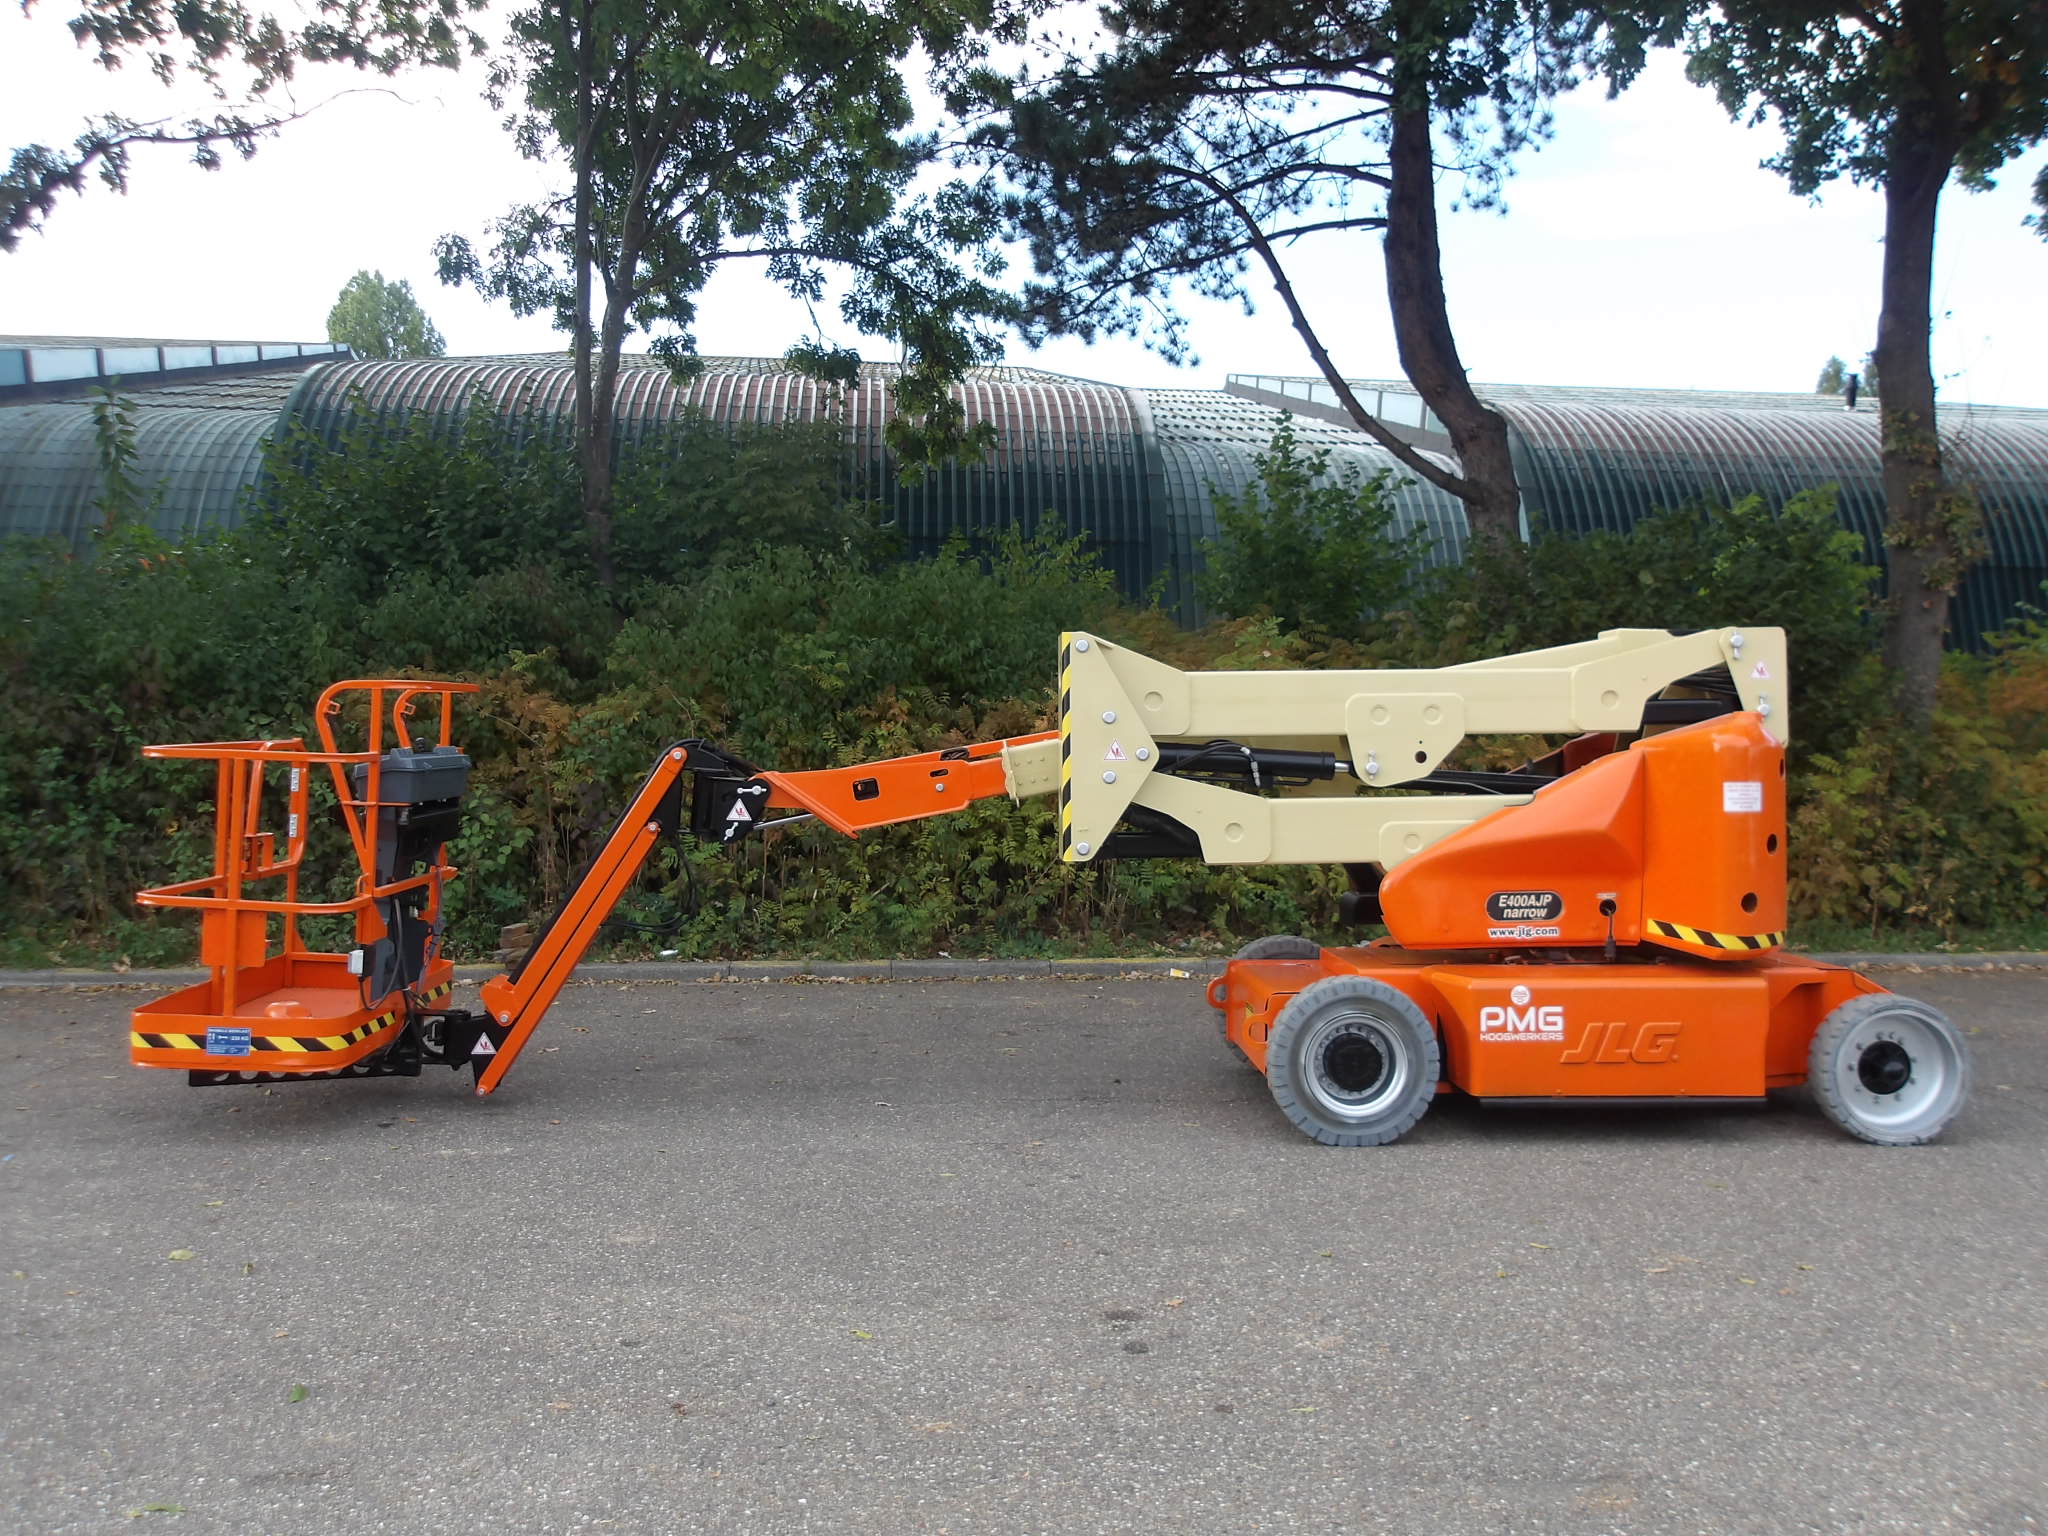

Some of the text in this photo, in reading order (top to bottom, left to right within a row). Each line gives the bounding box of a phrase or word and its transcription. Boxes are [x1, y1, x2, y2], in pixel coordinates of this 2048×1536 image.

[1498, 894, 1553, 907] E400AJP
[1503, 908, 1548, 919] narrow
[1489, 927, 1558, 938] www.jlg.com
[1480, 1006, 1564, 1032] PMG
[1560, 1022, 1682, 1064] JLG
